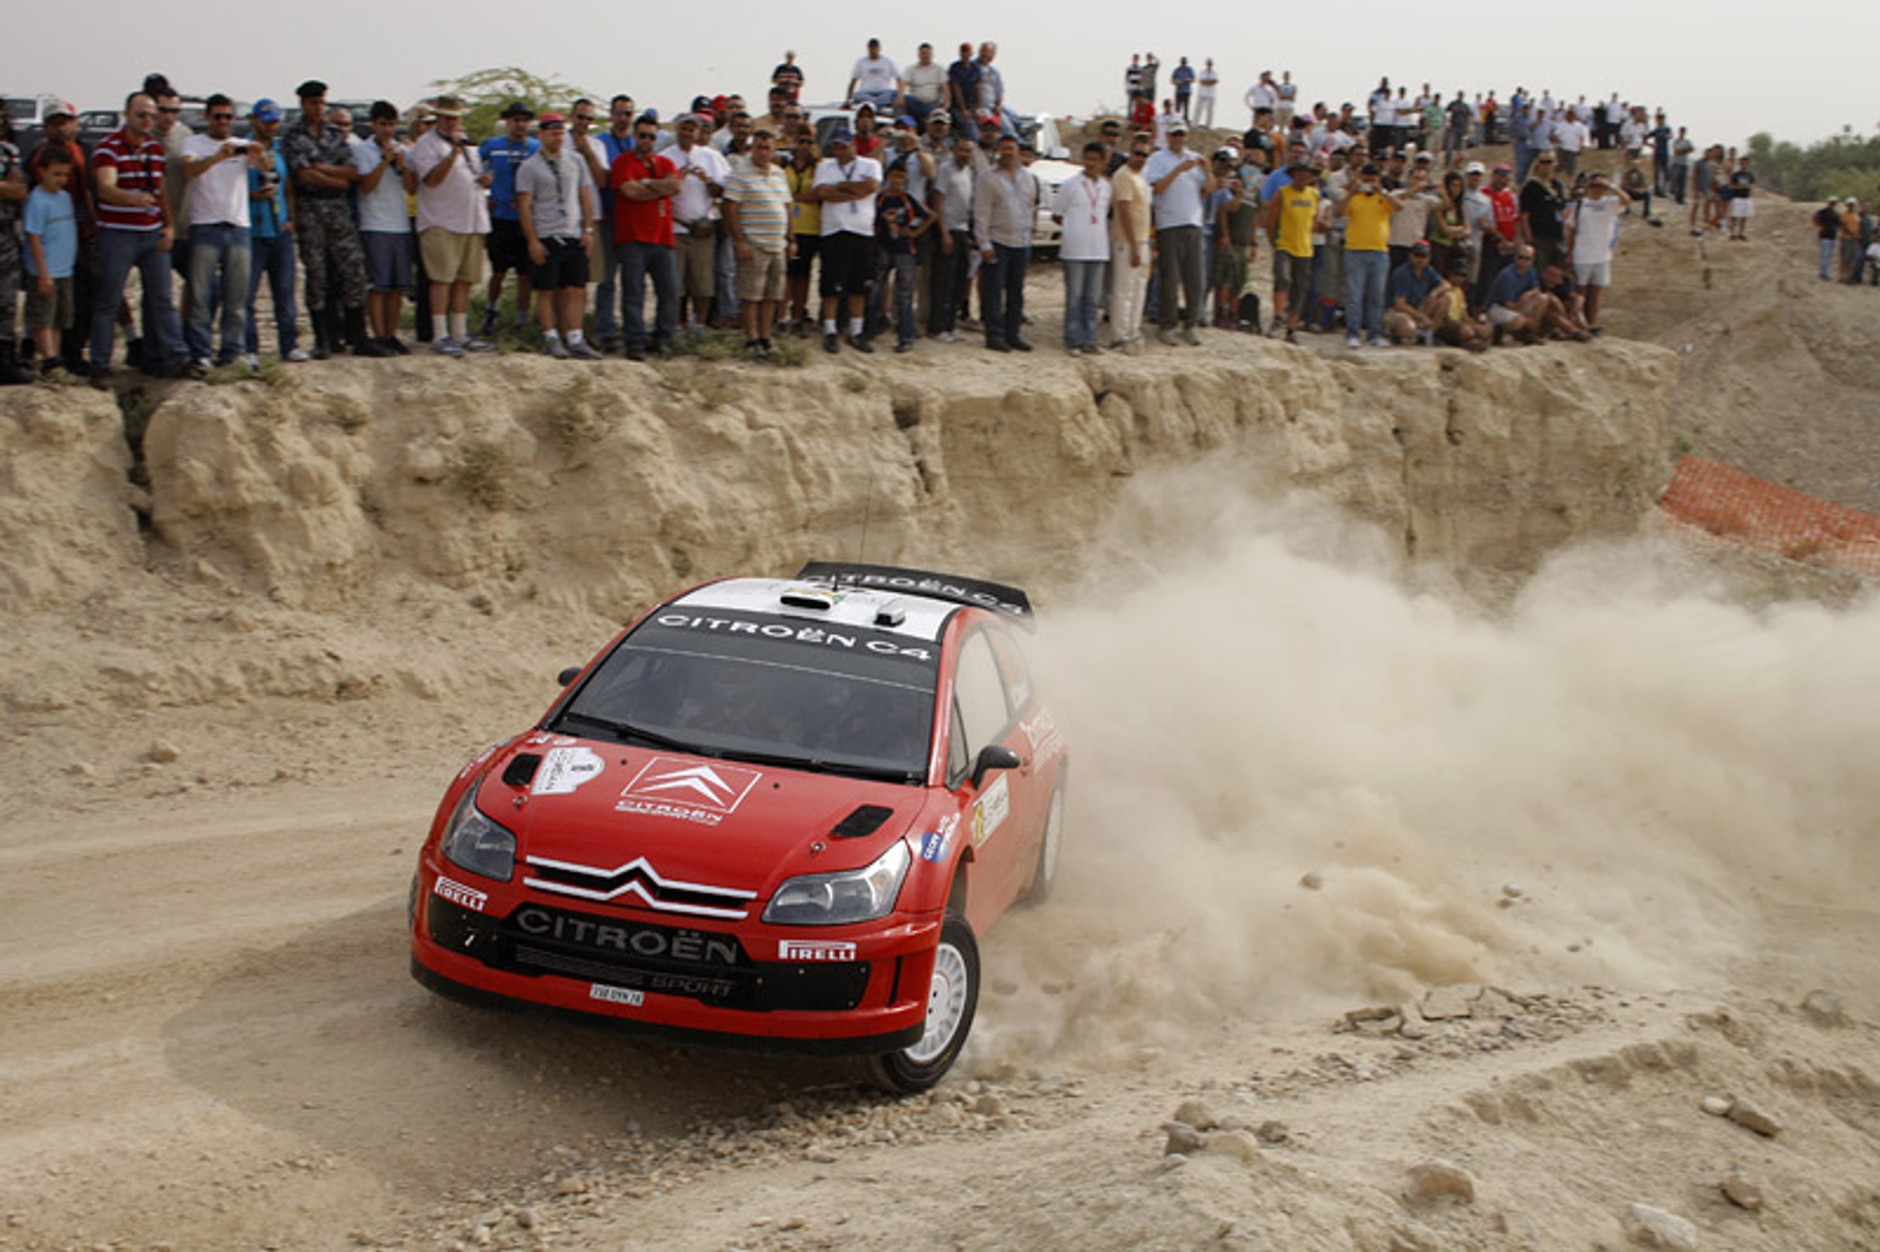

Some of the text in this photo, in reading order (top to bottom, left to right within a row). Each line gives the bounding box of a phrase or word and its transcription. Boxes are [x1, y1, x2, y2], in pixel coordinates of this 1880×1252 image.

[657, 614, 932, 661] CITROËN C4
[434, 875, 488, 912] PIRELLI
[516, 908, 739, 965] CITROËN
[778, 939, 857, 962] PIRELLI
